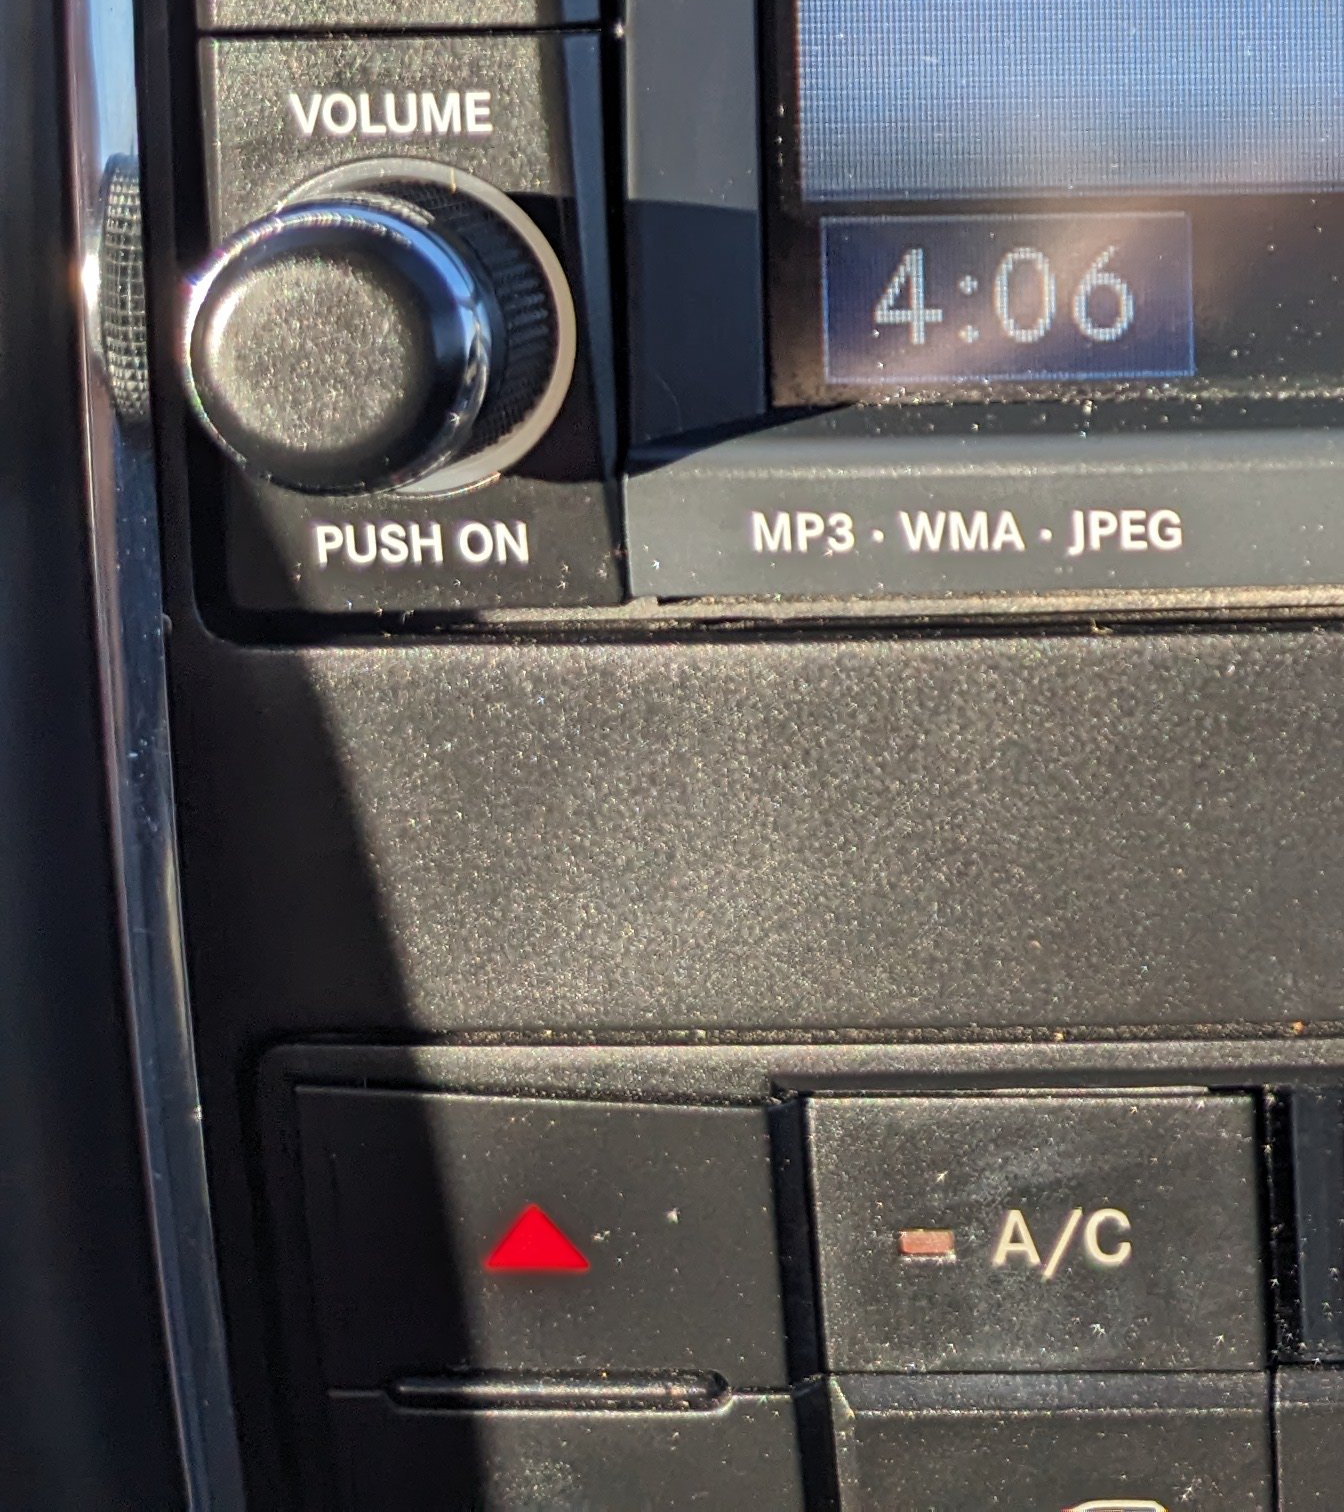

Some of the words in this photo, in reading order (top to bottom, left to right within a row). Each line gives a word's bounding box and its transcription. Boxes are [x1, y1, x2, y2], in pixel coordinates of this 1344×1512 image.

[290, 91, 493, 134] VOLUME
[873, 245, 1137, 345] 4:06
[316, 524, 442, 565] PUSH
[458, 522, 530, 562] ON
[750, 511, 856, 554] MP3
[899, 509, 1025, 552] WMA
[1067, 508, 1184, 556] JPEG
[990, 1207, 1133, 1281] A/C
